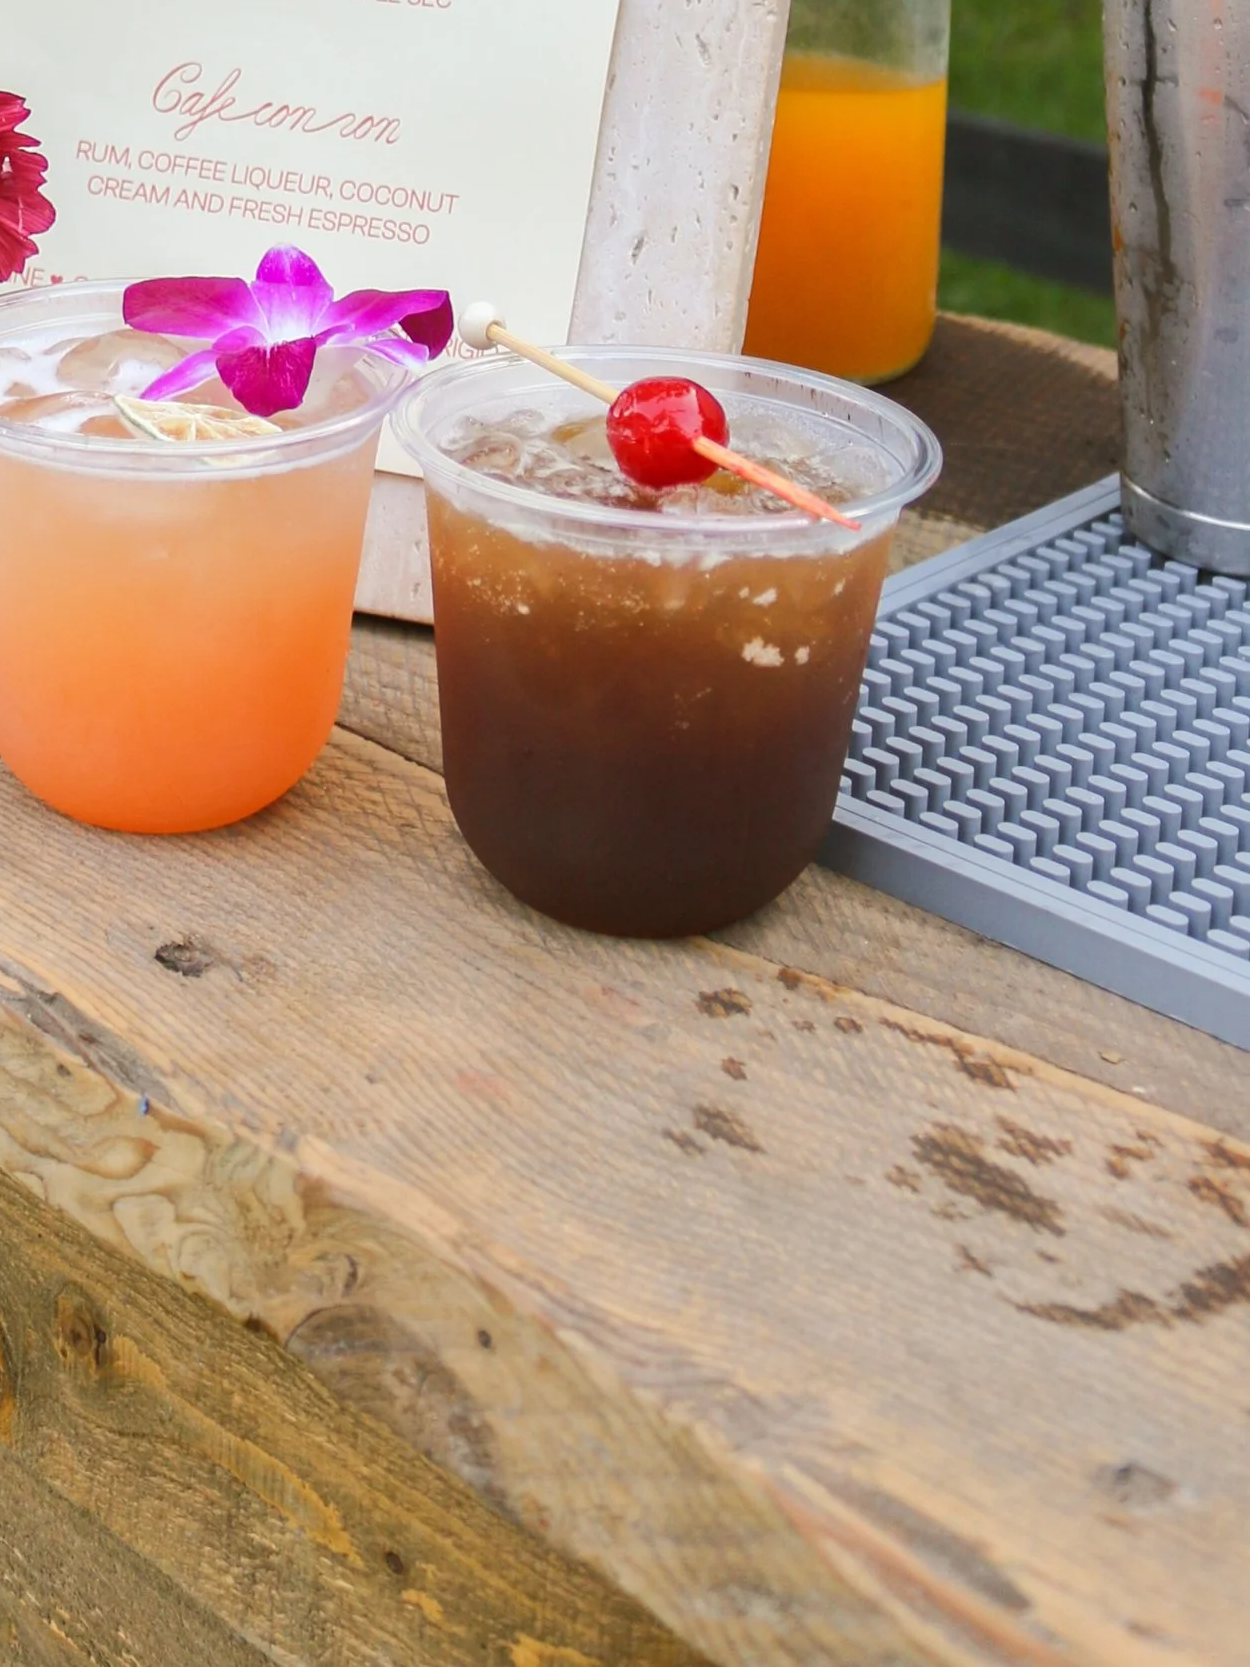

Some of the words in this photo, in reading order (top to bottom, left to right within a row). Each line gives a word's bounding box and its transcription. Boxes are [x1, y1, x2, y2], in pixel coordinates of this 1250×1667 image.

[152, 61, 239, 141] Cafe
[252, 101, 317, 133] con
[338, 112, 401, 144] ron
[75, 139, 132, 170] RUM,
[137, 150, 227, 182] COFFEE
[231, 163, 334, 200] LIQUEUR,
[339, 179, 460, 215] COCONUT
[87, 174, 170, 205] CREAM
[173, 188, 224, 214] AND
[228, 197, 304, 227] FRESH
[307, 208, 431, 246] ESPRESSO
